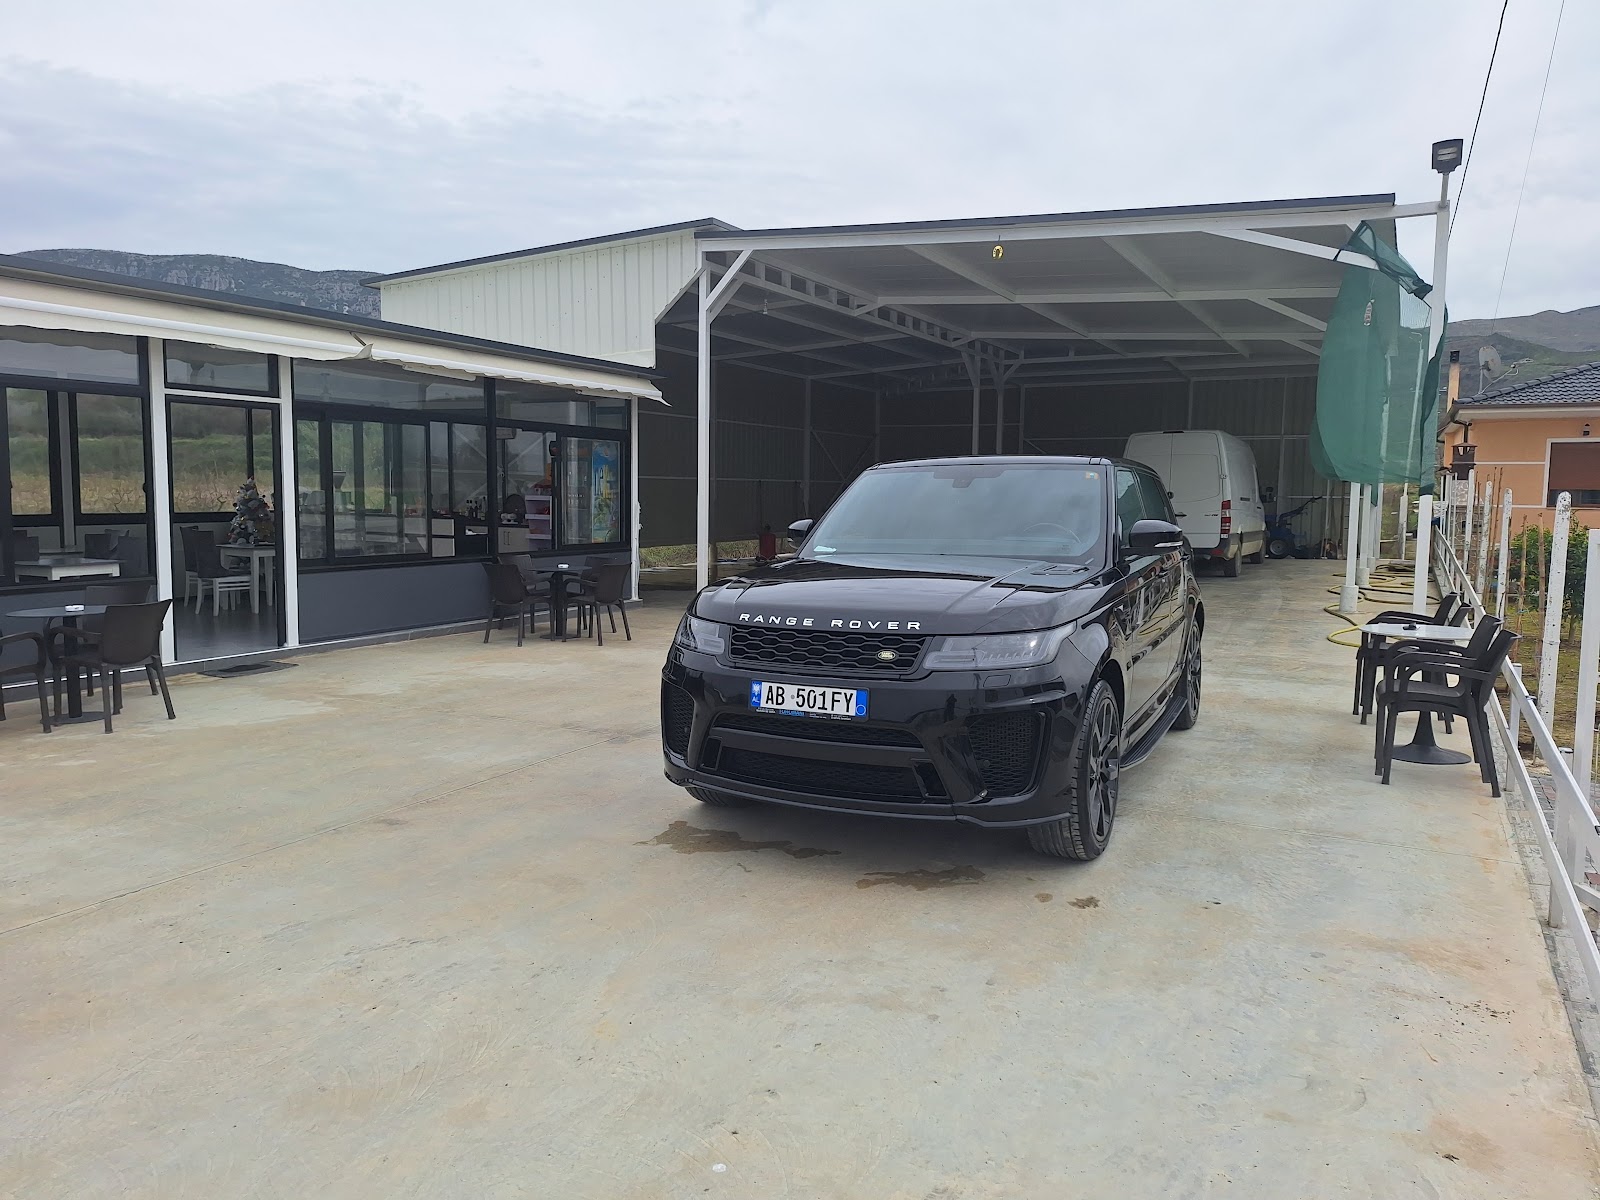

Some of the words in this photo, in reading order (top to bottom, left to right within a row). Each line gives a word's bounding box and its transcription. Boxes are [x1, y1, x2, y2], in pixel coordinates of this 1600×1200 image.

[739, 613, 815, 627] RANGE
[830, 619, 921, 631] ROVER
[765, 685, 785, 706] AB
[795, 688, 854, 713] 501FY
